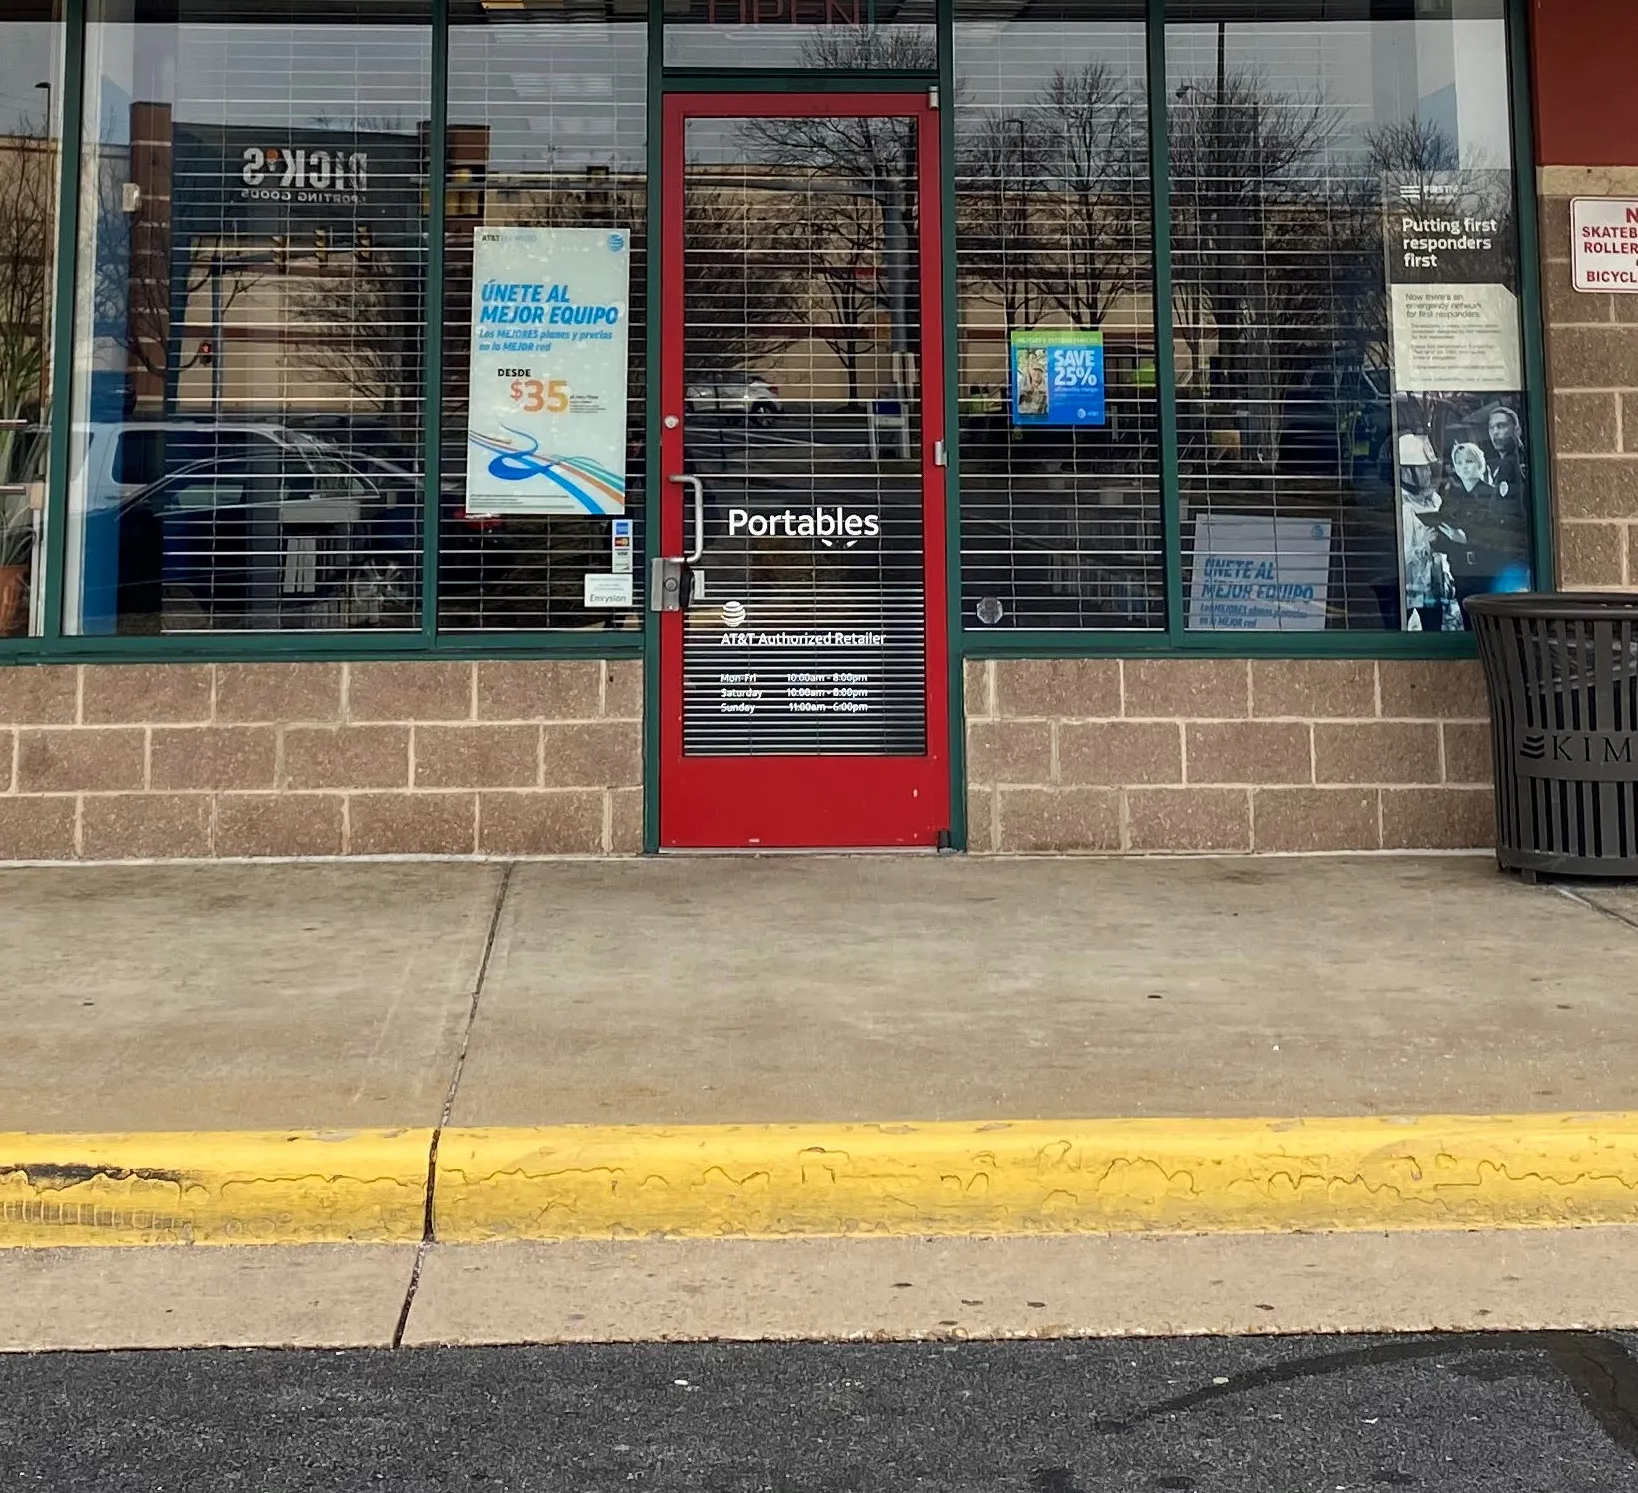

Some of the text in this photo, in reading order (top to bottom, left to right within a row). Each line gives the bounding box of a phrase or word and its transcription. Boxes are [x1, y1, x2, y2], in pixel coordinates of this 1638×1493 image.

[1402, 216, 1498, 235] Putting first
[1582, 226, 1638, 239] SKATEB
[1403, 235, 1492, 253] responders
[1404, 252, 1438, 268] first
[481, 279, 570, 304] ÚNETE AL
[1405, 293, 1424, 302] Now
[479, 306, 619, 326] MEJOR EQUIPO
[1406, 310, 1417, 318] for
[502, 342, 534, 352] MEJOR
[535, 342, 552, 352] red
[1054, 349, 1096, 367] SAVE
[497, 368, 531, 377] DESDE
[1054, 366, 1098, 386] 25%
[510, 378, 569, 413] $35
[728, 507, 879, 537] Portables
[1253, 561, 1275, 581] AL
[720, 631, 887, 646] AT&T Authorized Retailer
[720, 688, 763, 700] Saturday
[720, 701, 756, 714] Sunday
